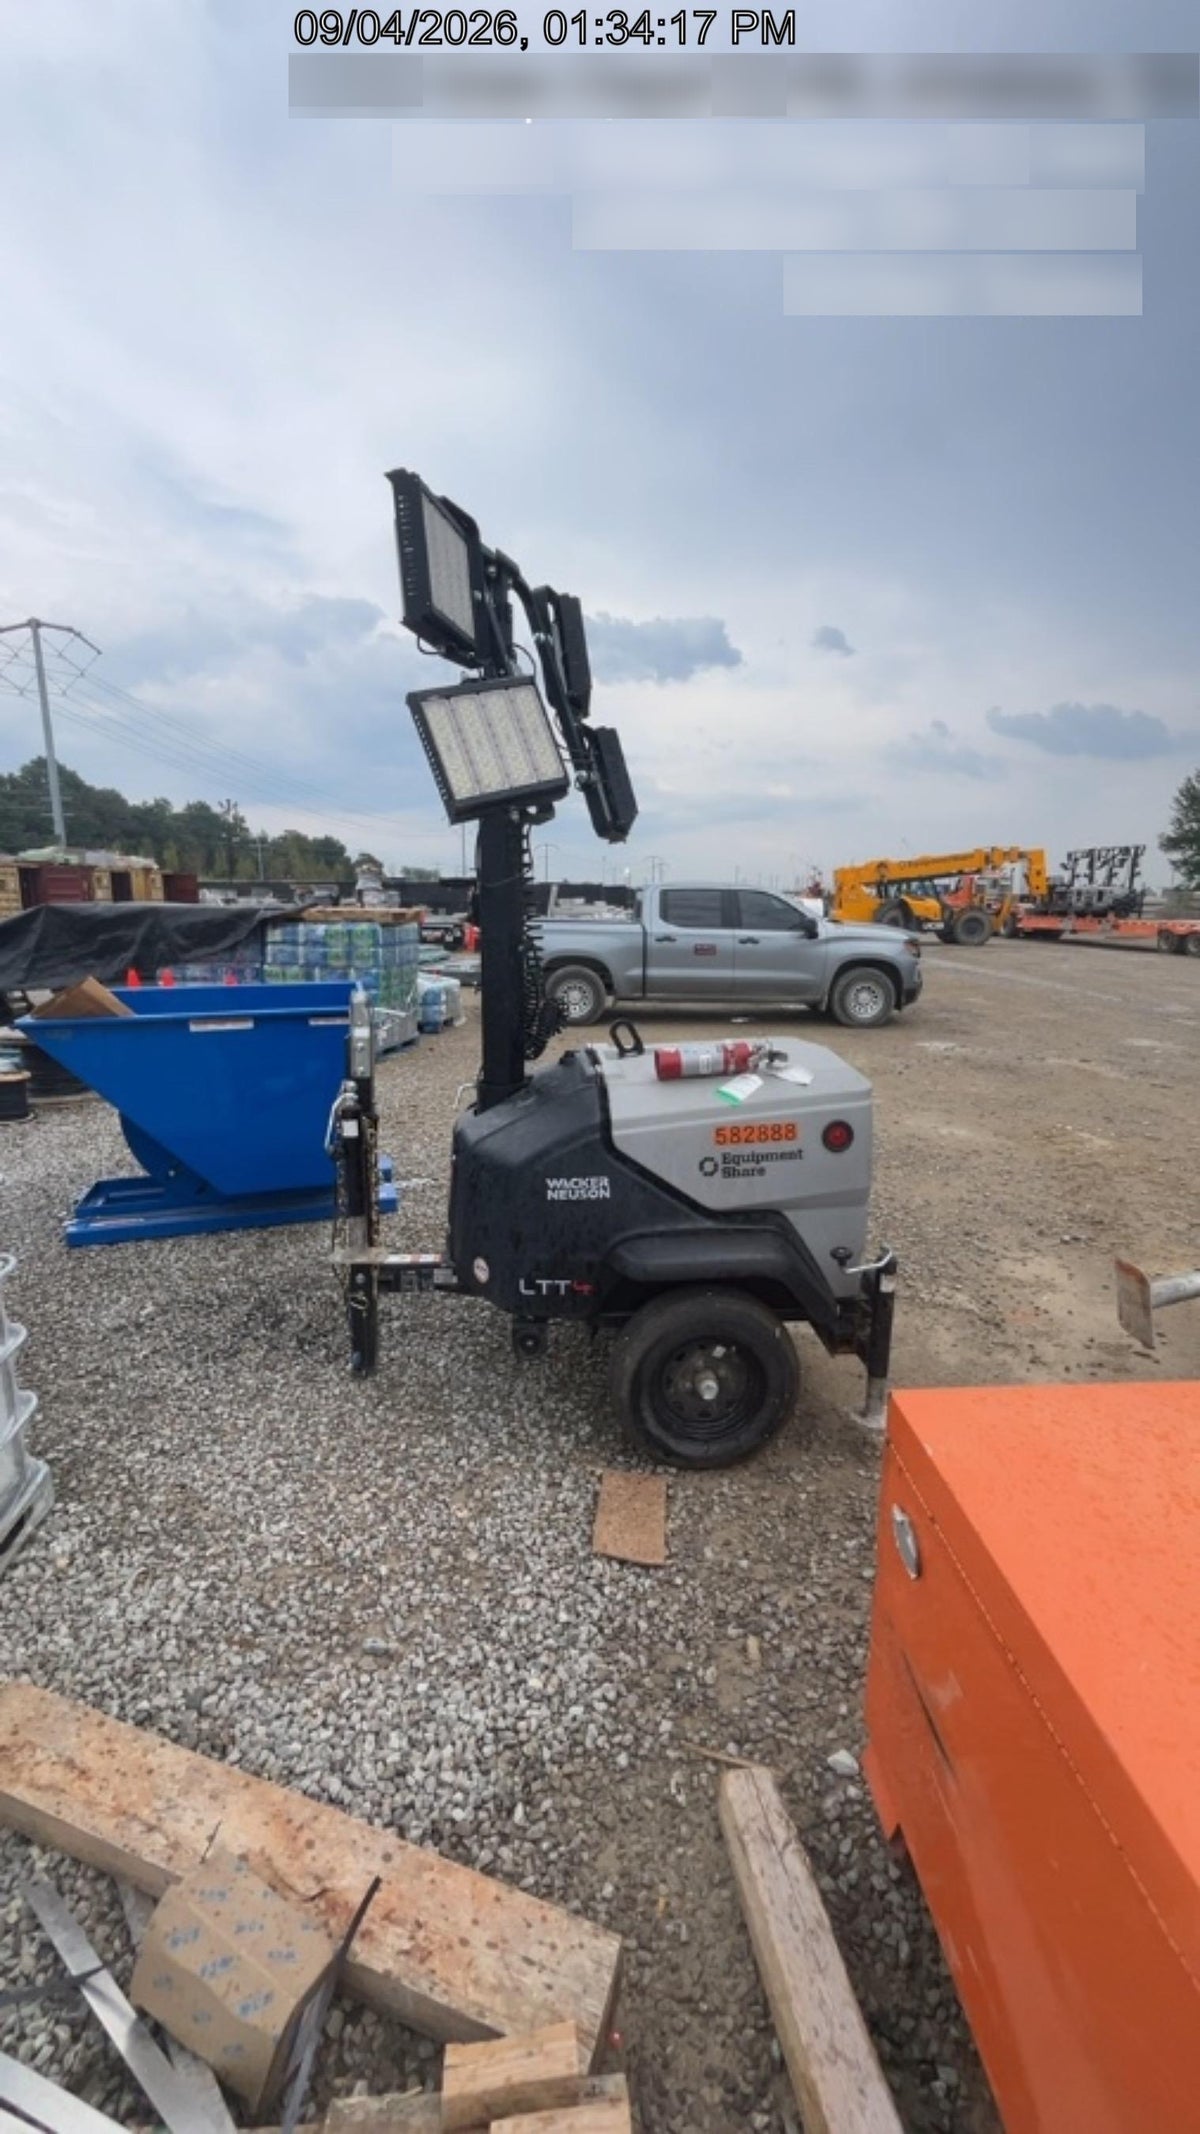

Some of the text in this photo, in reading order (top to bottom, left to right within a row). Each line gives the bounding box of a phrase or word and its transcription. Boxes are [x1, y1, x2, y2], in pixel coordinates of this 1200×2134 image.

[714, 1123, 797, 1146] 582888
[722, 1149, 804, 1166] Equipment
[722, 1166, 767, 1179] Share
[544, 1176, 609, 1189] WACKER
[546, 1187, 611, 1200] NEUSON
